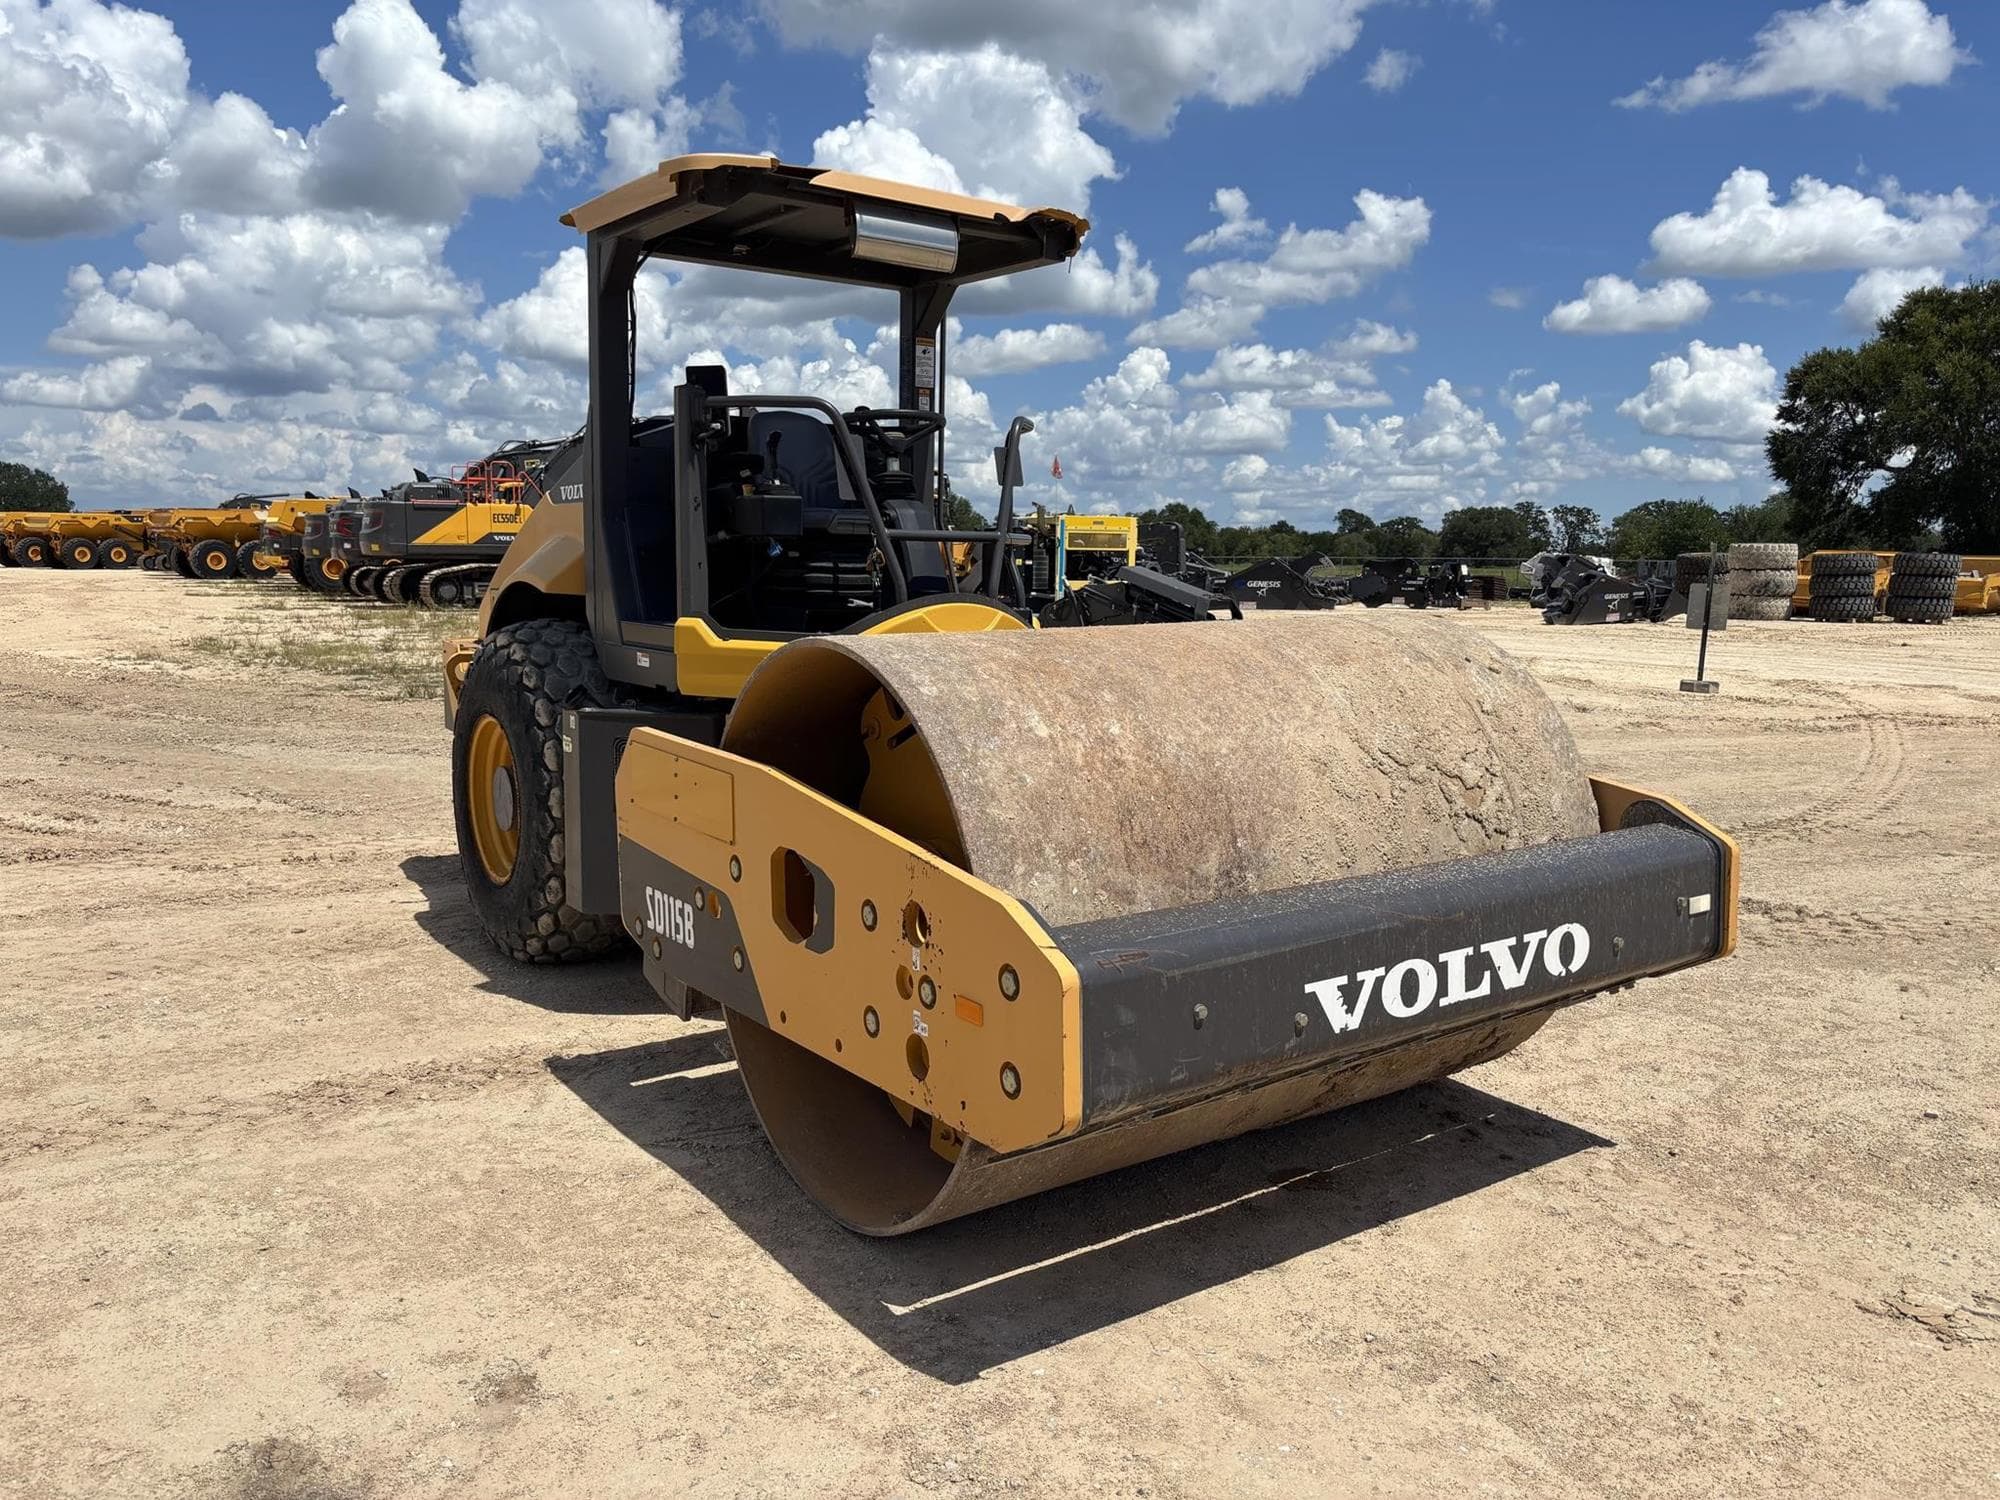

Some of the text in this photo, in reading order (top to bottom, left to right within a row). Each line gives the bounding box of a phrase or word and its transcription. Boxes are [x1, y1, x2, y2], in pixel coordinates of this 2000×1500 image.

[560, 483, 583, 500] VOLV
[1247, 580, 1281, 588] GENESIS
[646, 885, 695, 949] SD115B
[1304, 922, 1591, 1034] VOLVO
